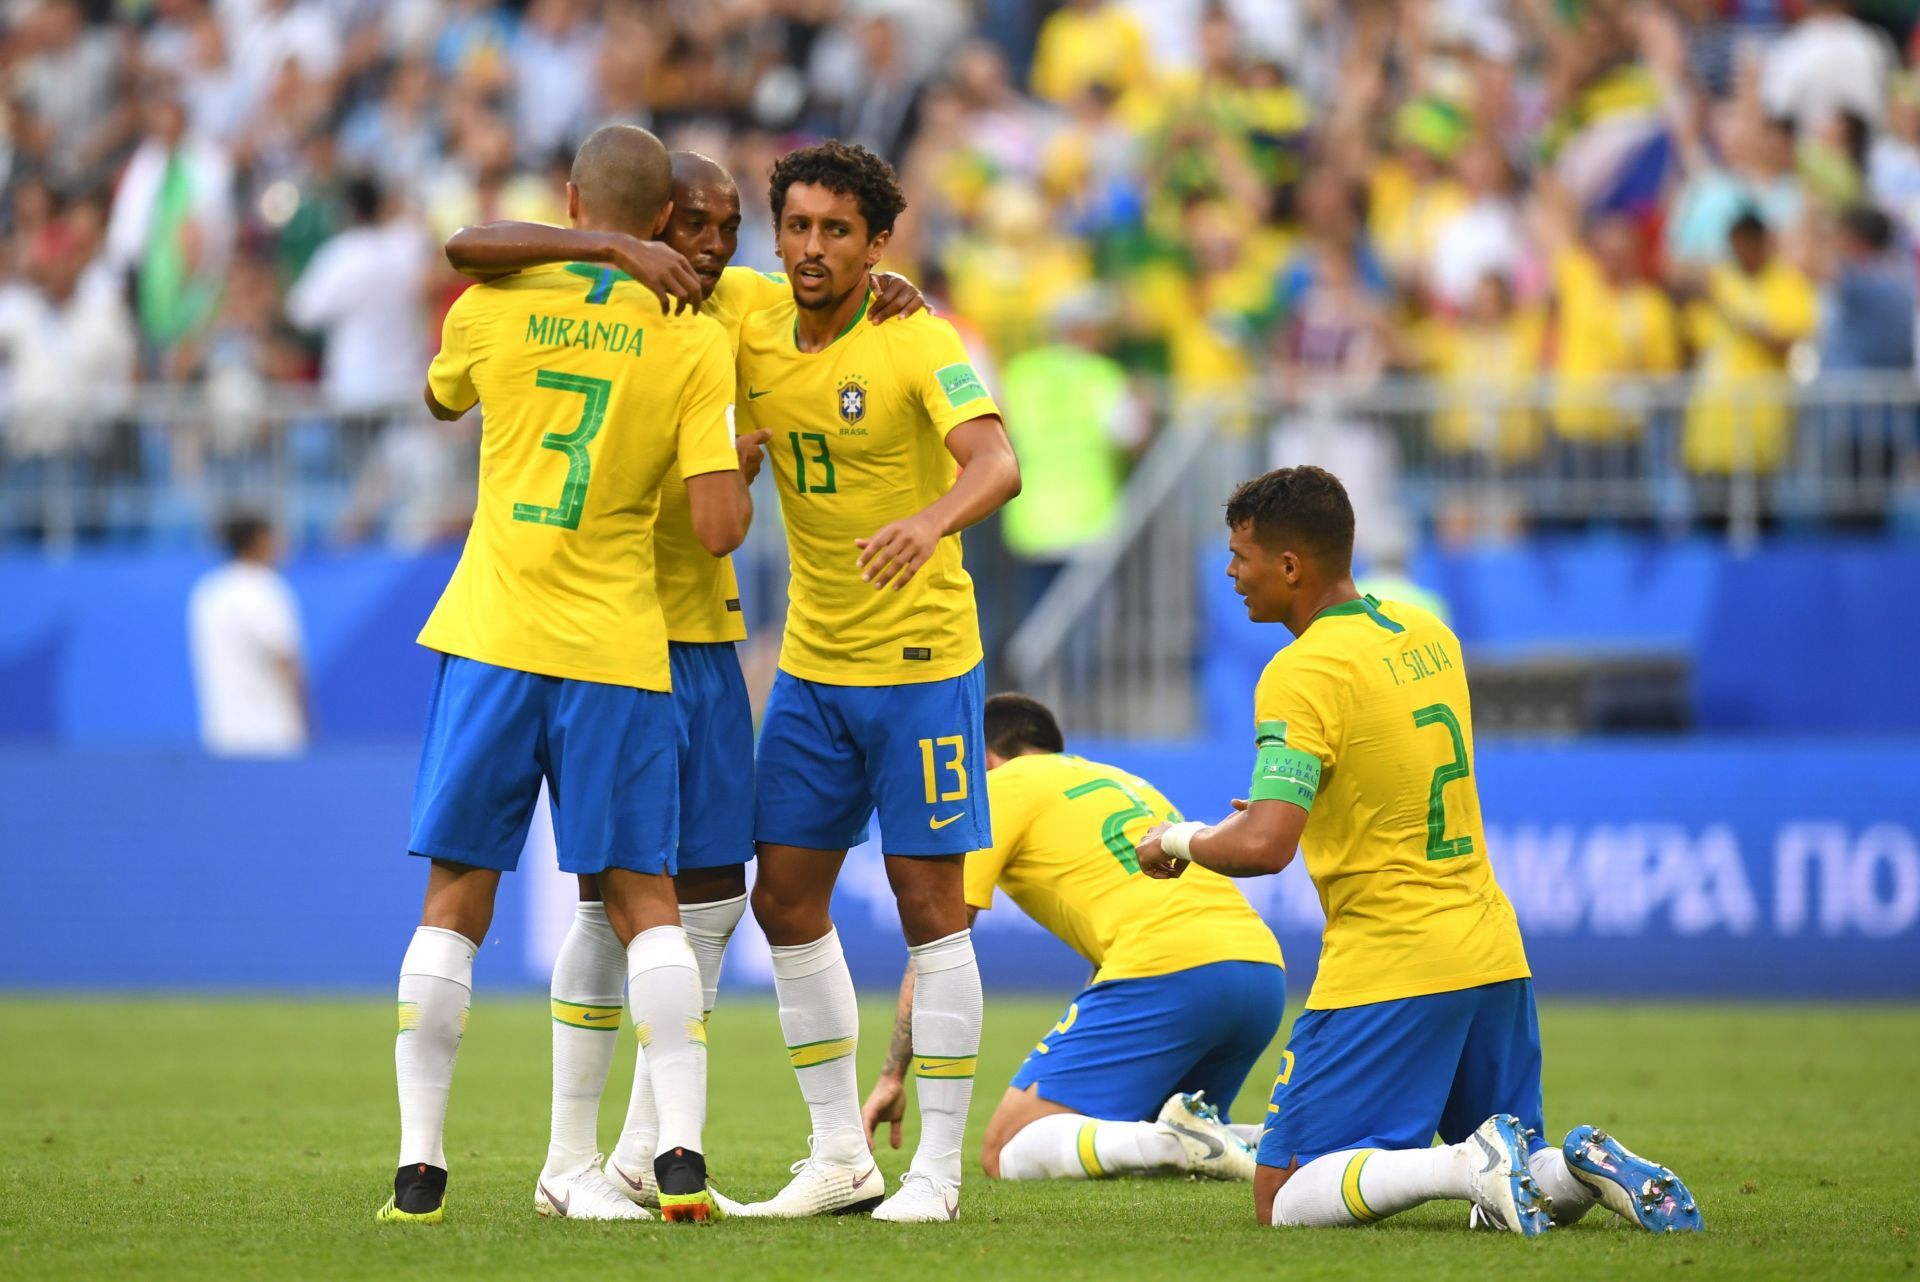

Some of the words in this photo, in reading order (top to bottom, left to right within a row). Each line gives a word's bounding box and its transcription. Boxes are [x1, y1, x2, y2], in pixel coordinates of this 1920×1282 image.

[525, 314, 644, 358] MIRANDA
[512, 369, 612, 531] 3
[788, 431, 837, 494] 13
[839, 428, 869, 436] BRASIL
[1382, 656, 1406, 686] T.
[1401, 641, 1453, 681] SILVA
[918, 735, 968, 804] 13
[1411, 703, 1474, 861] 2
